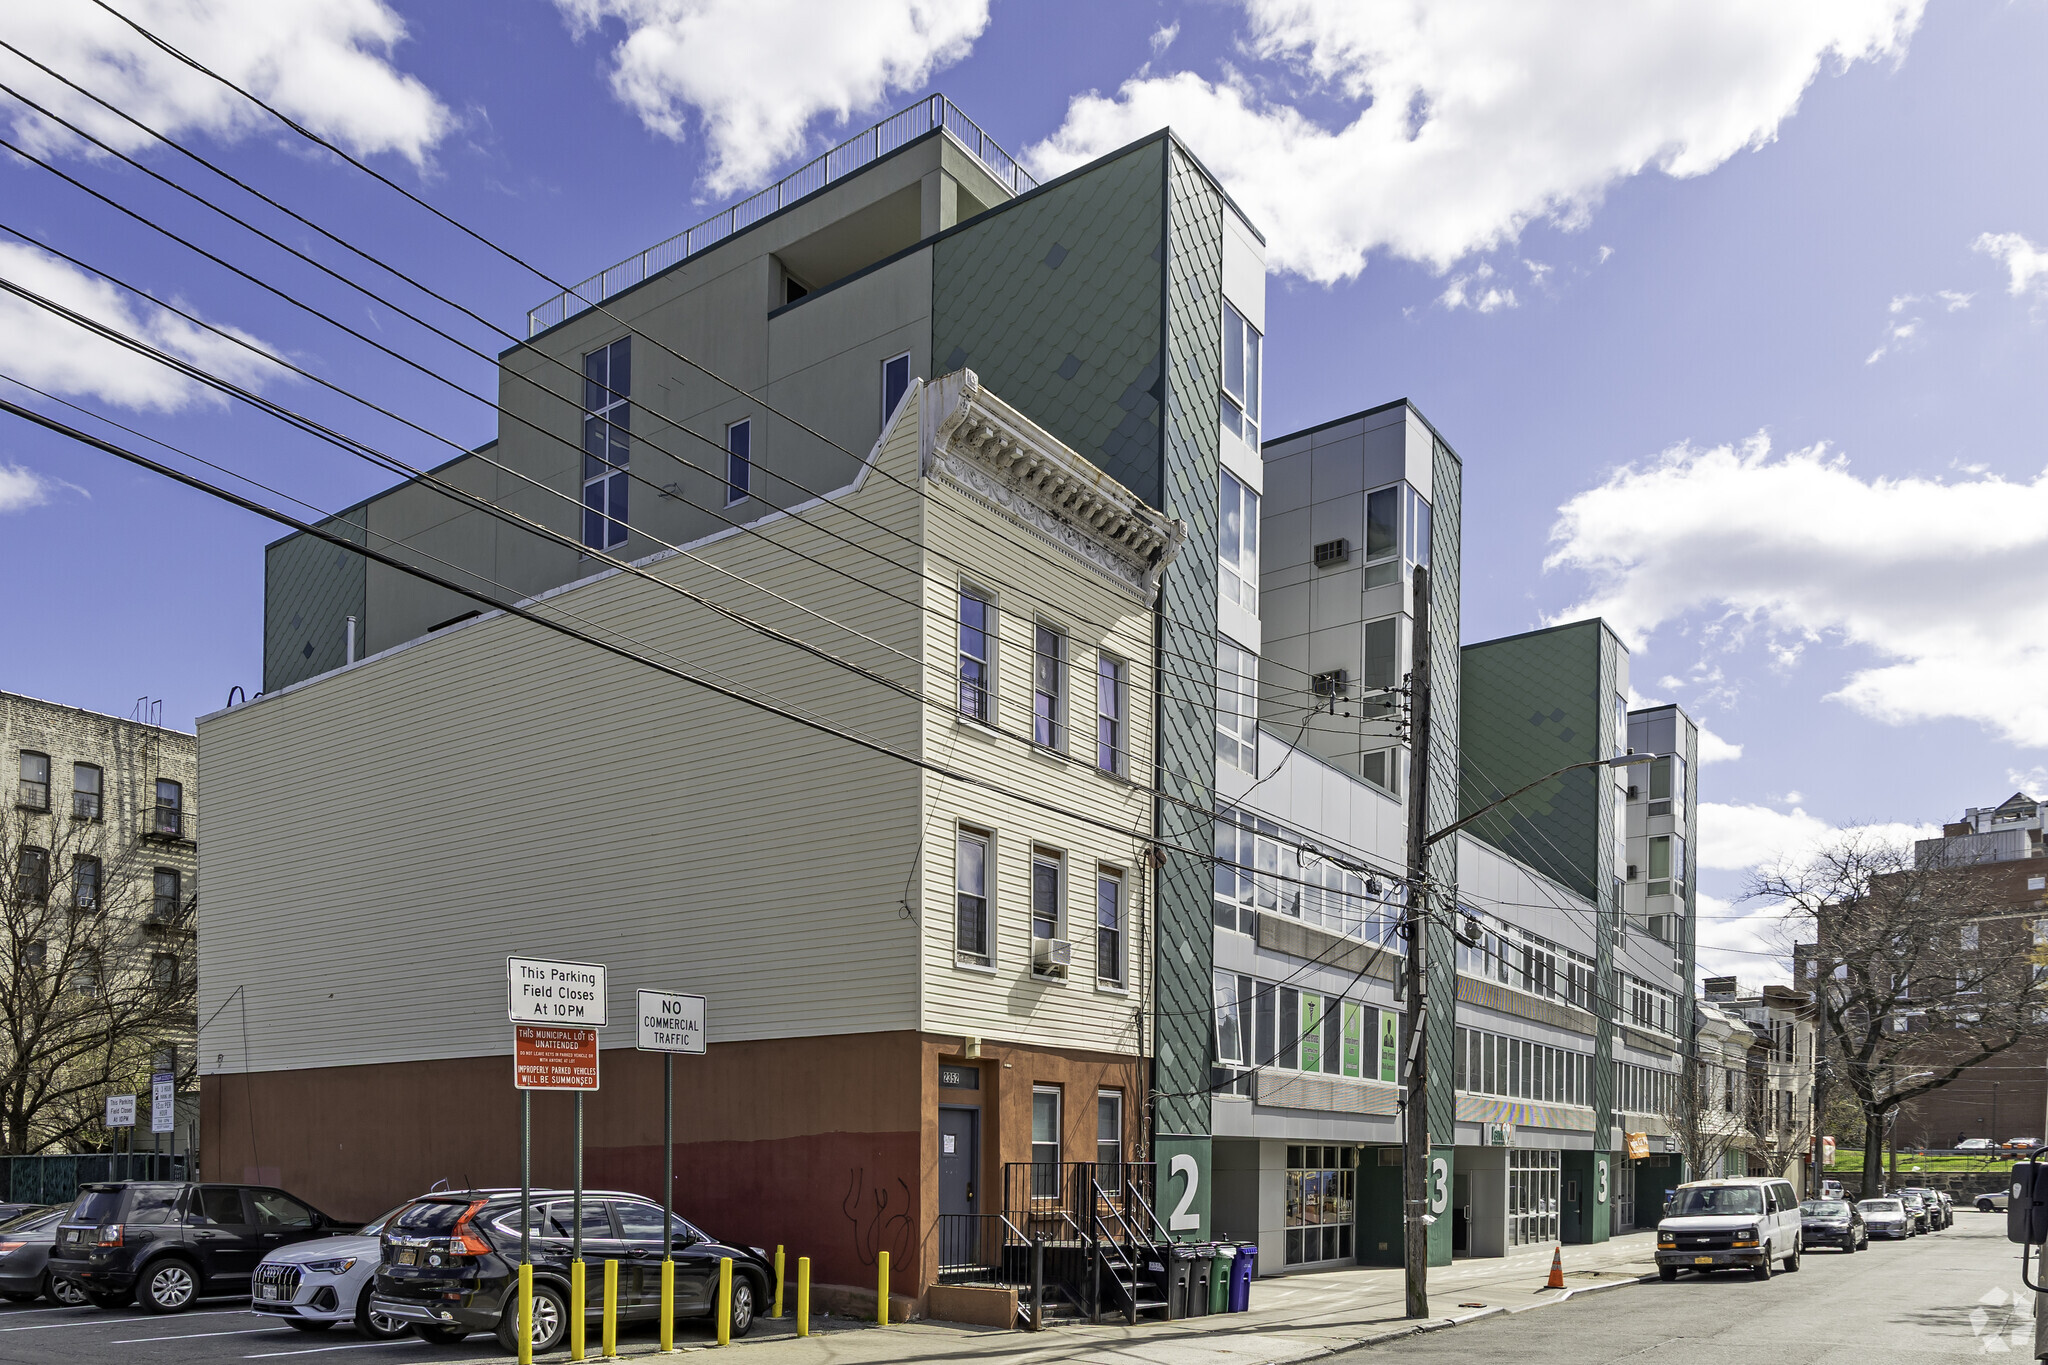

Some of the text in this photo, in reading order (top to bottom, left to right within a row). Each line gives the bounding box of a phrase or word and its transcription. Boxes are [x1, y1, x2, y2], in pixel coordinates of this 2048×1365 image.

[520, 965, 596, 988] This Parking
[523, 984, 595, 1001] Field Closes
[533, 1002, 548, 1015] At
[662, 1000, 682, 1015] NO
[644, 1015, 699, 1032] COMMERCIAL
[518, 1029, 595, 1042] THIS MUNICIPAL LOT IS
[654, 1031, 690, 1046] TRAFFIC
[535, 1040, 579, 1050] UNATTENDED
[517, 1065, 597, 1076] IMPROPERLY PARKED VEHICLES
[943, 1071, 960, 1084] 2352
[521, 1075, 594, 1086] WILL BE SUMMONSED
[1431, 1157, 1448, 1214] 3
[1598, 1159, 1608, 1203] 3
[1169, 1153, 1200, 1231] 2
